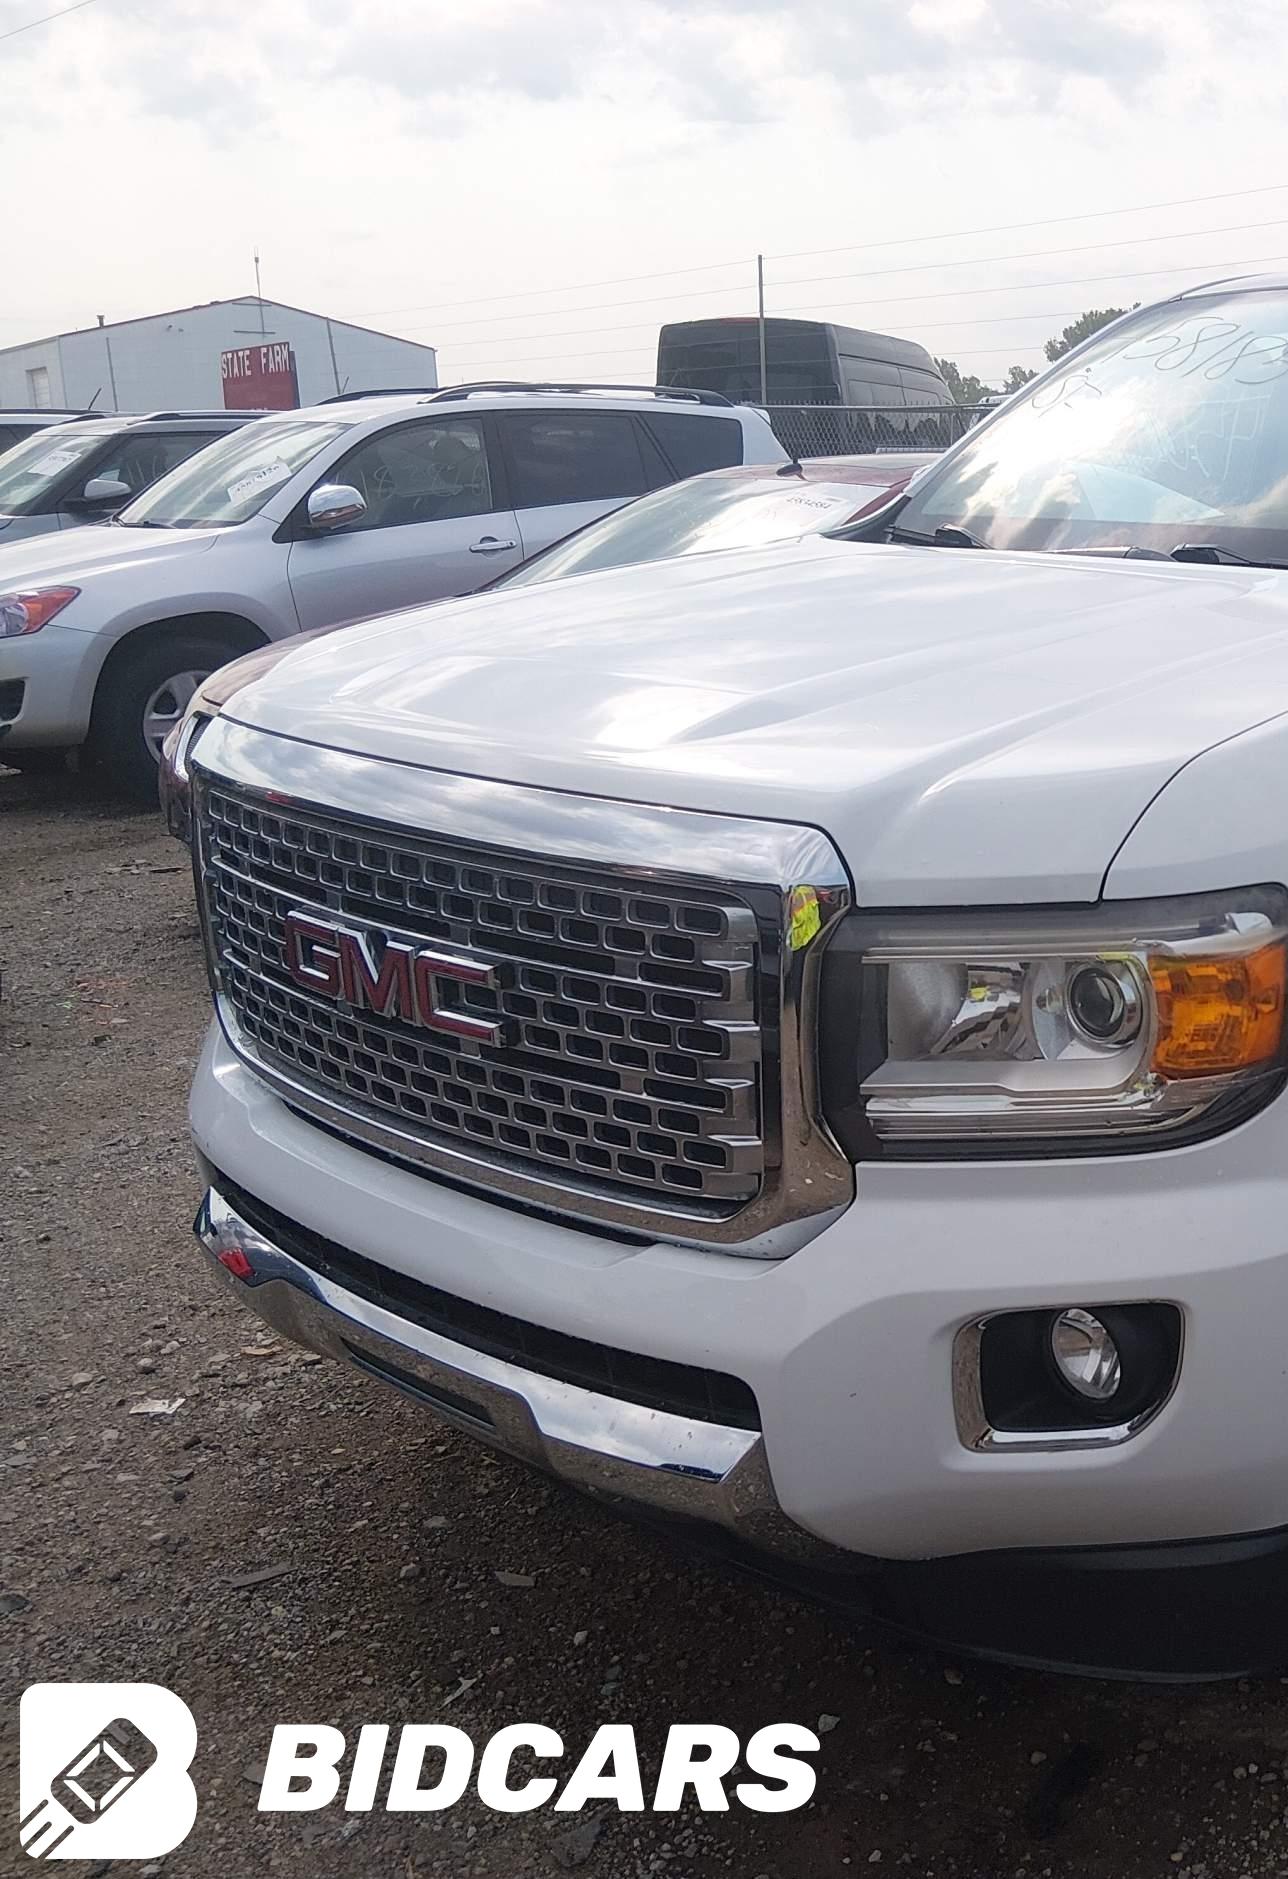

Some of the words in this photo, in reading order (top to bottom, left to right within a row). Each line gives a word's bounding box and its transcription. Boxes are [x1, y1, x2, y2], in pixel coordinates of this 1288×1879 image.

[221, 349, 252, 379] STATE
[260, 343, 290, 374] FARM
[284, 910, 502, 1047] GMC
